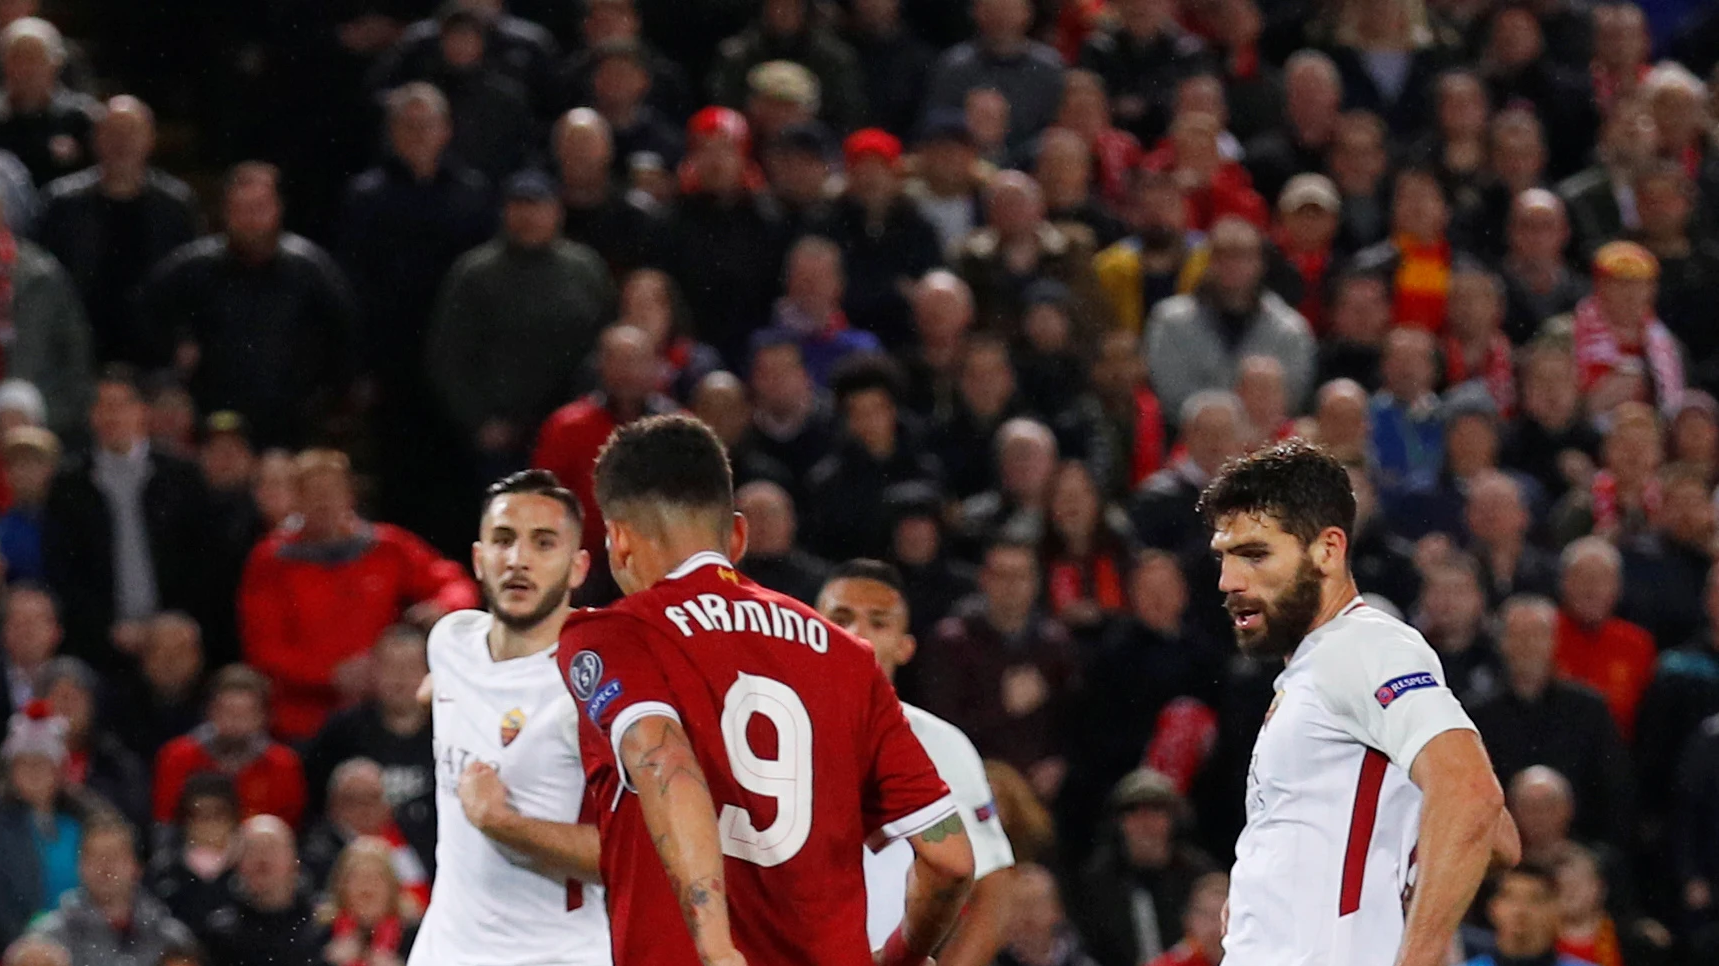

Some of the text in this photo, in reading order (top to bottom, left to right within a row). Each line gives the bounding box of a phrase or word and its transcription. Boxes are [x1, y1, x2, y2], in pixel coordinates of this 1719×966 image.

[665, 593, 828, 653] FIRMINO
[1391, 675, 1435, 692] RESPECT
[718, 670, 813, 867] 9
